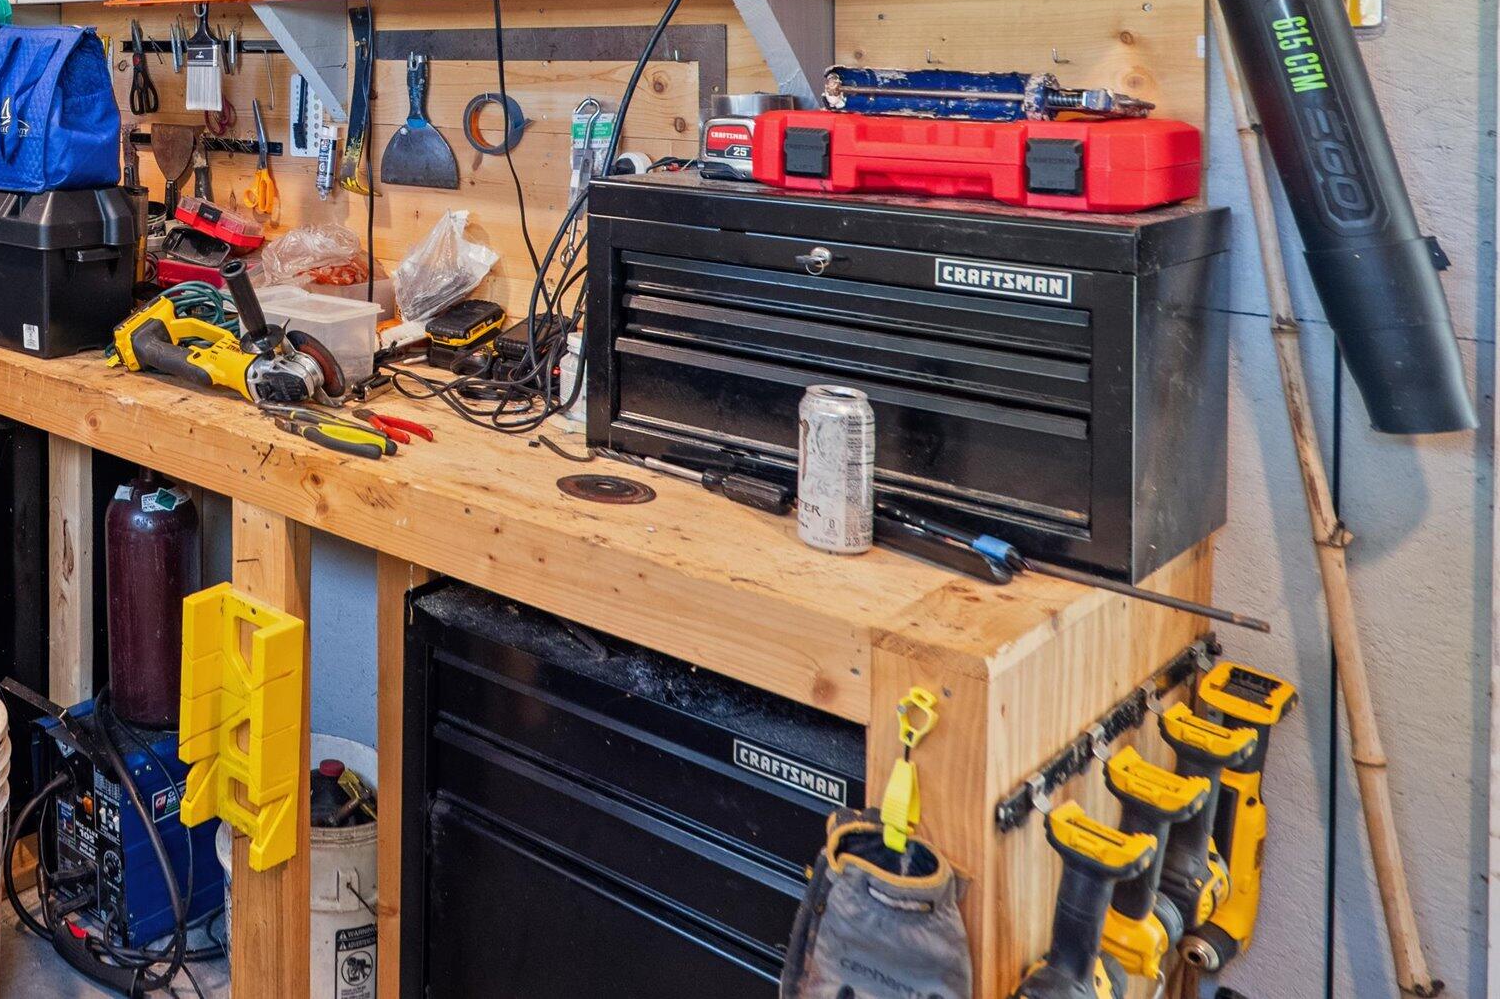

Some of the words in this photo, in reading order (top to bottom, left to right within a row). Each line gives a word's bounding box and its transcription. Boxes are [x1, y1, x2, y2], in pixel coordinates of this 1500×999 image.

[1272, 16, 1314, 52] 615
[1283, 52, 1329, 93] CFM
[942, 265, 1063, 295] CRAFTSMAN
[740, 747, 840, 799] CRAFTSMAN
